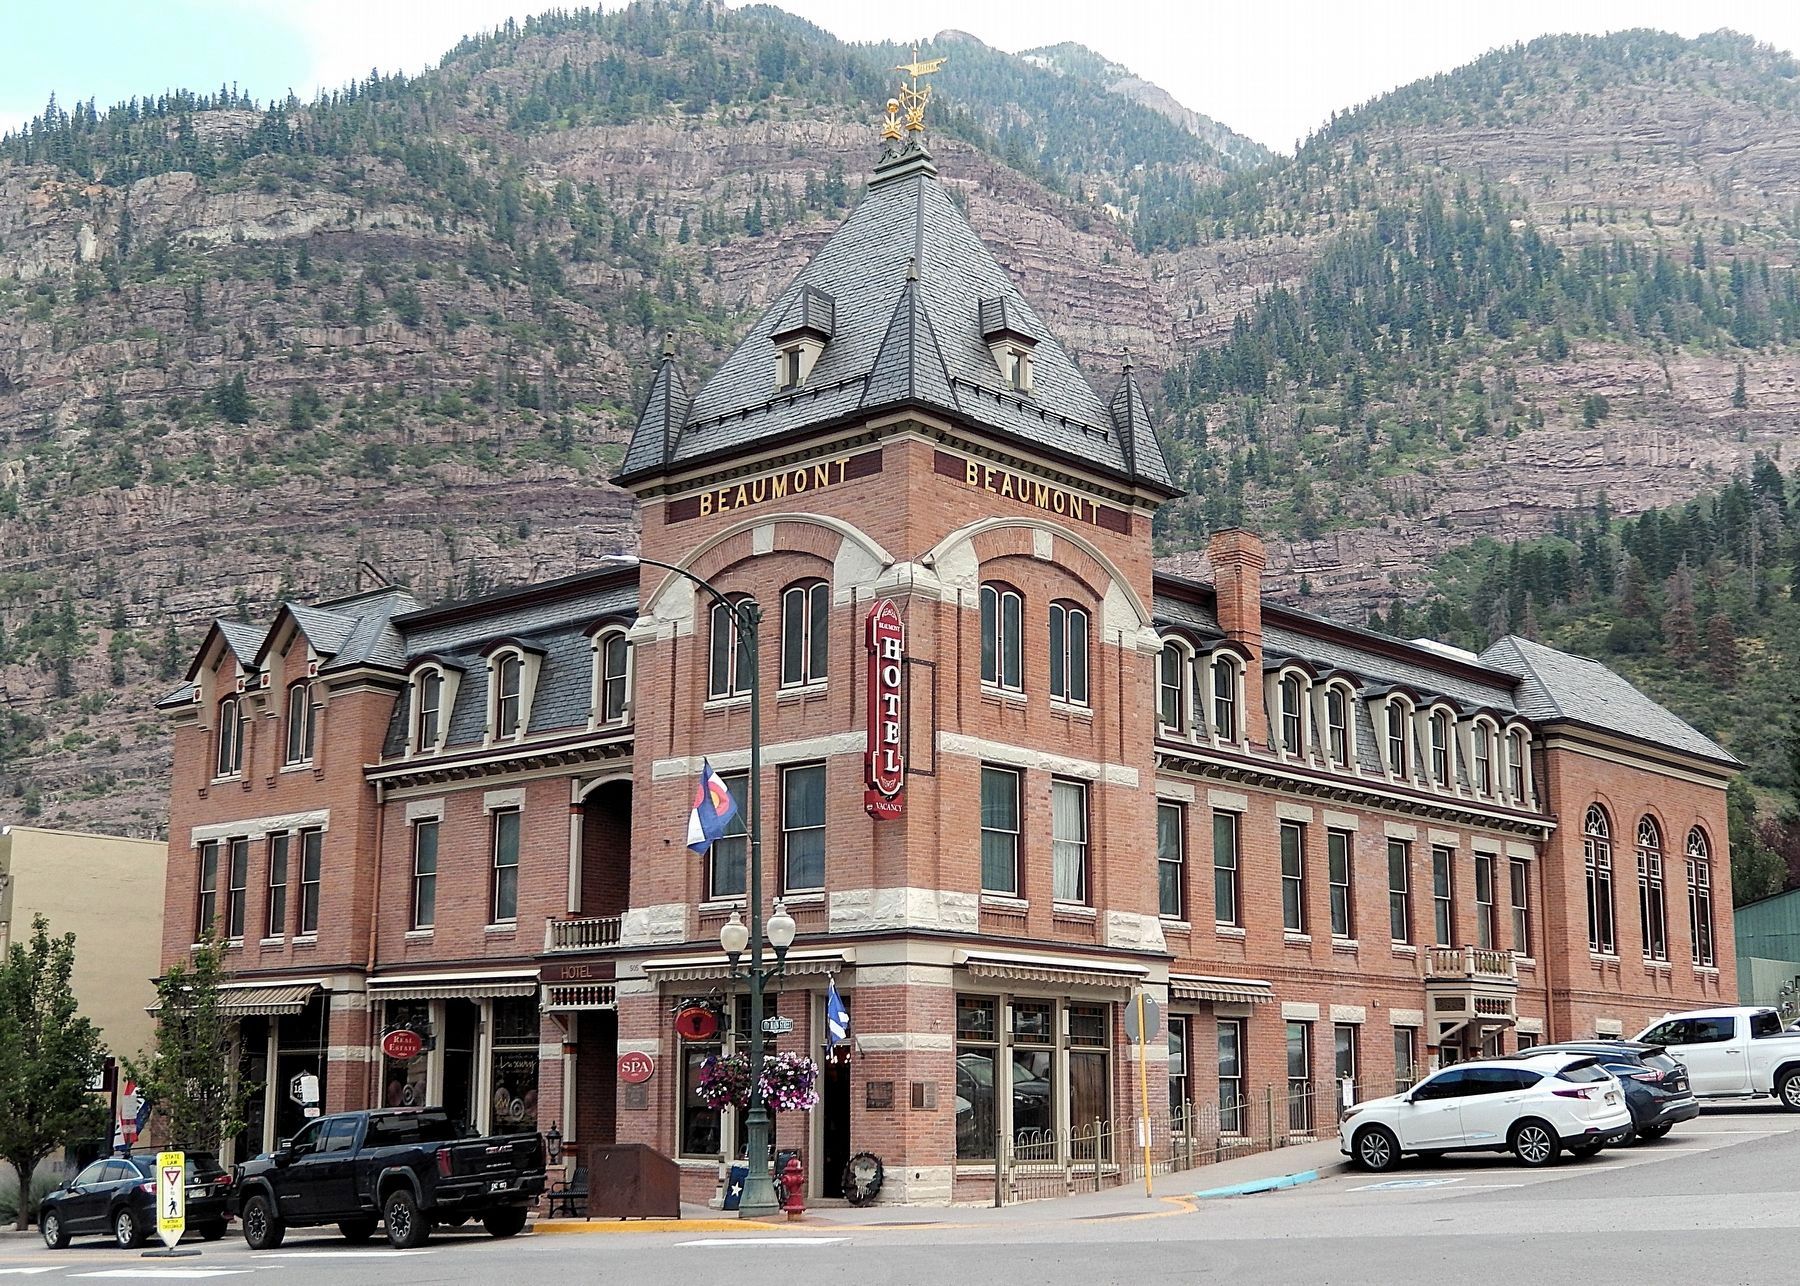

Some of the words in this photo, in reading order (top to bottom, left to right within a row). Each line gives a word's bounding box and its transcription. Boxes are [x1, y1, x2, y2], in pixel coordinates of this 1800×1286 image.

[700, 457, 850, 517] BEAUMONT
[966, 459, 1101, 525] BEAUMONT
[878, 621, 901, 632] BEAUMONT
[881, 636, 902, 773] HOTEL
[876, 802, 903, 812] VACANCY
[561, 965, 593, 979] HOTEL
[621, 1061, 649, 1073] SPA
